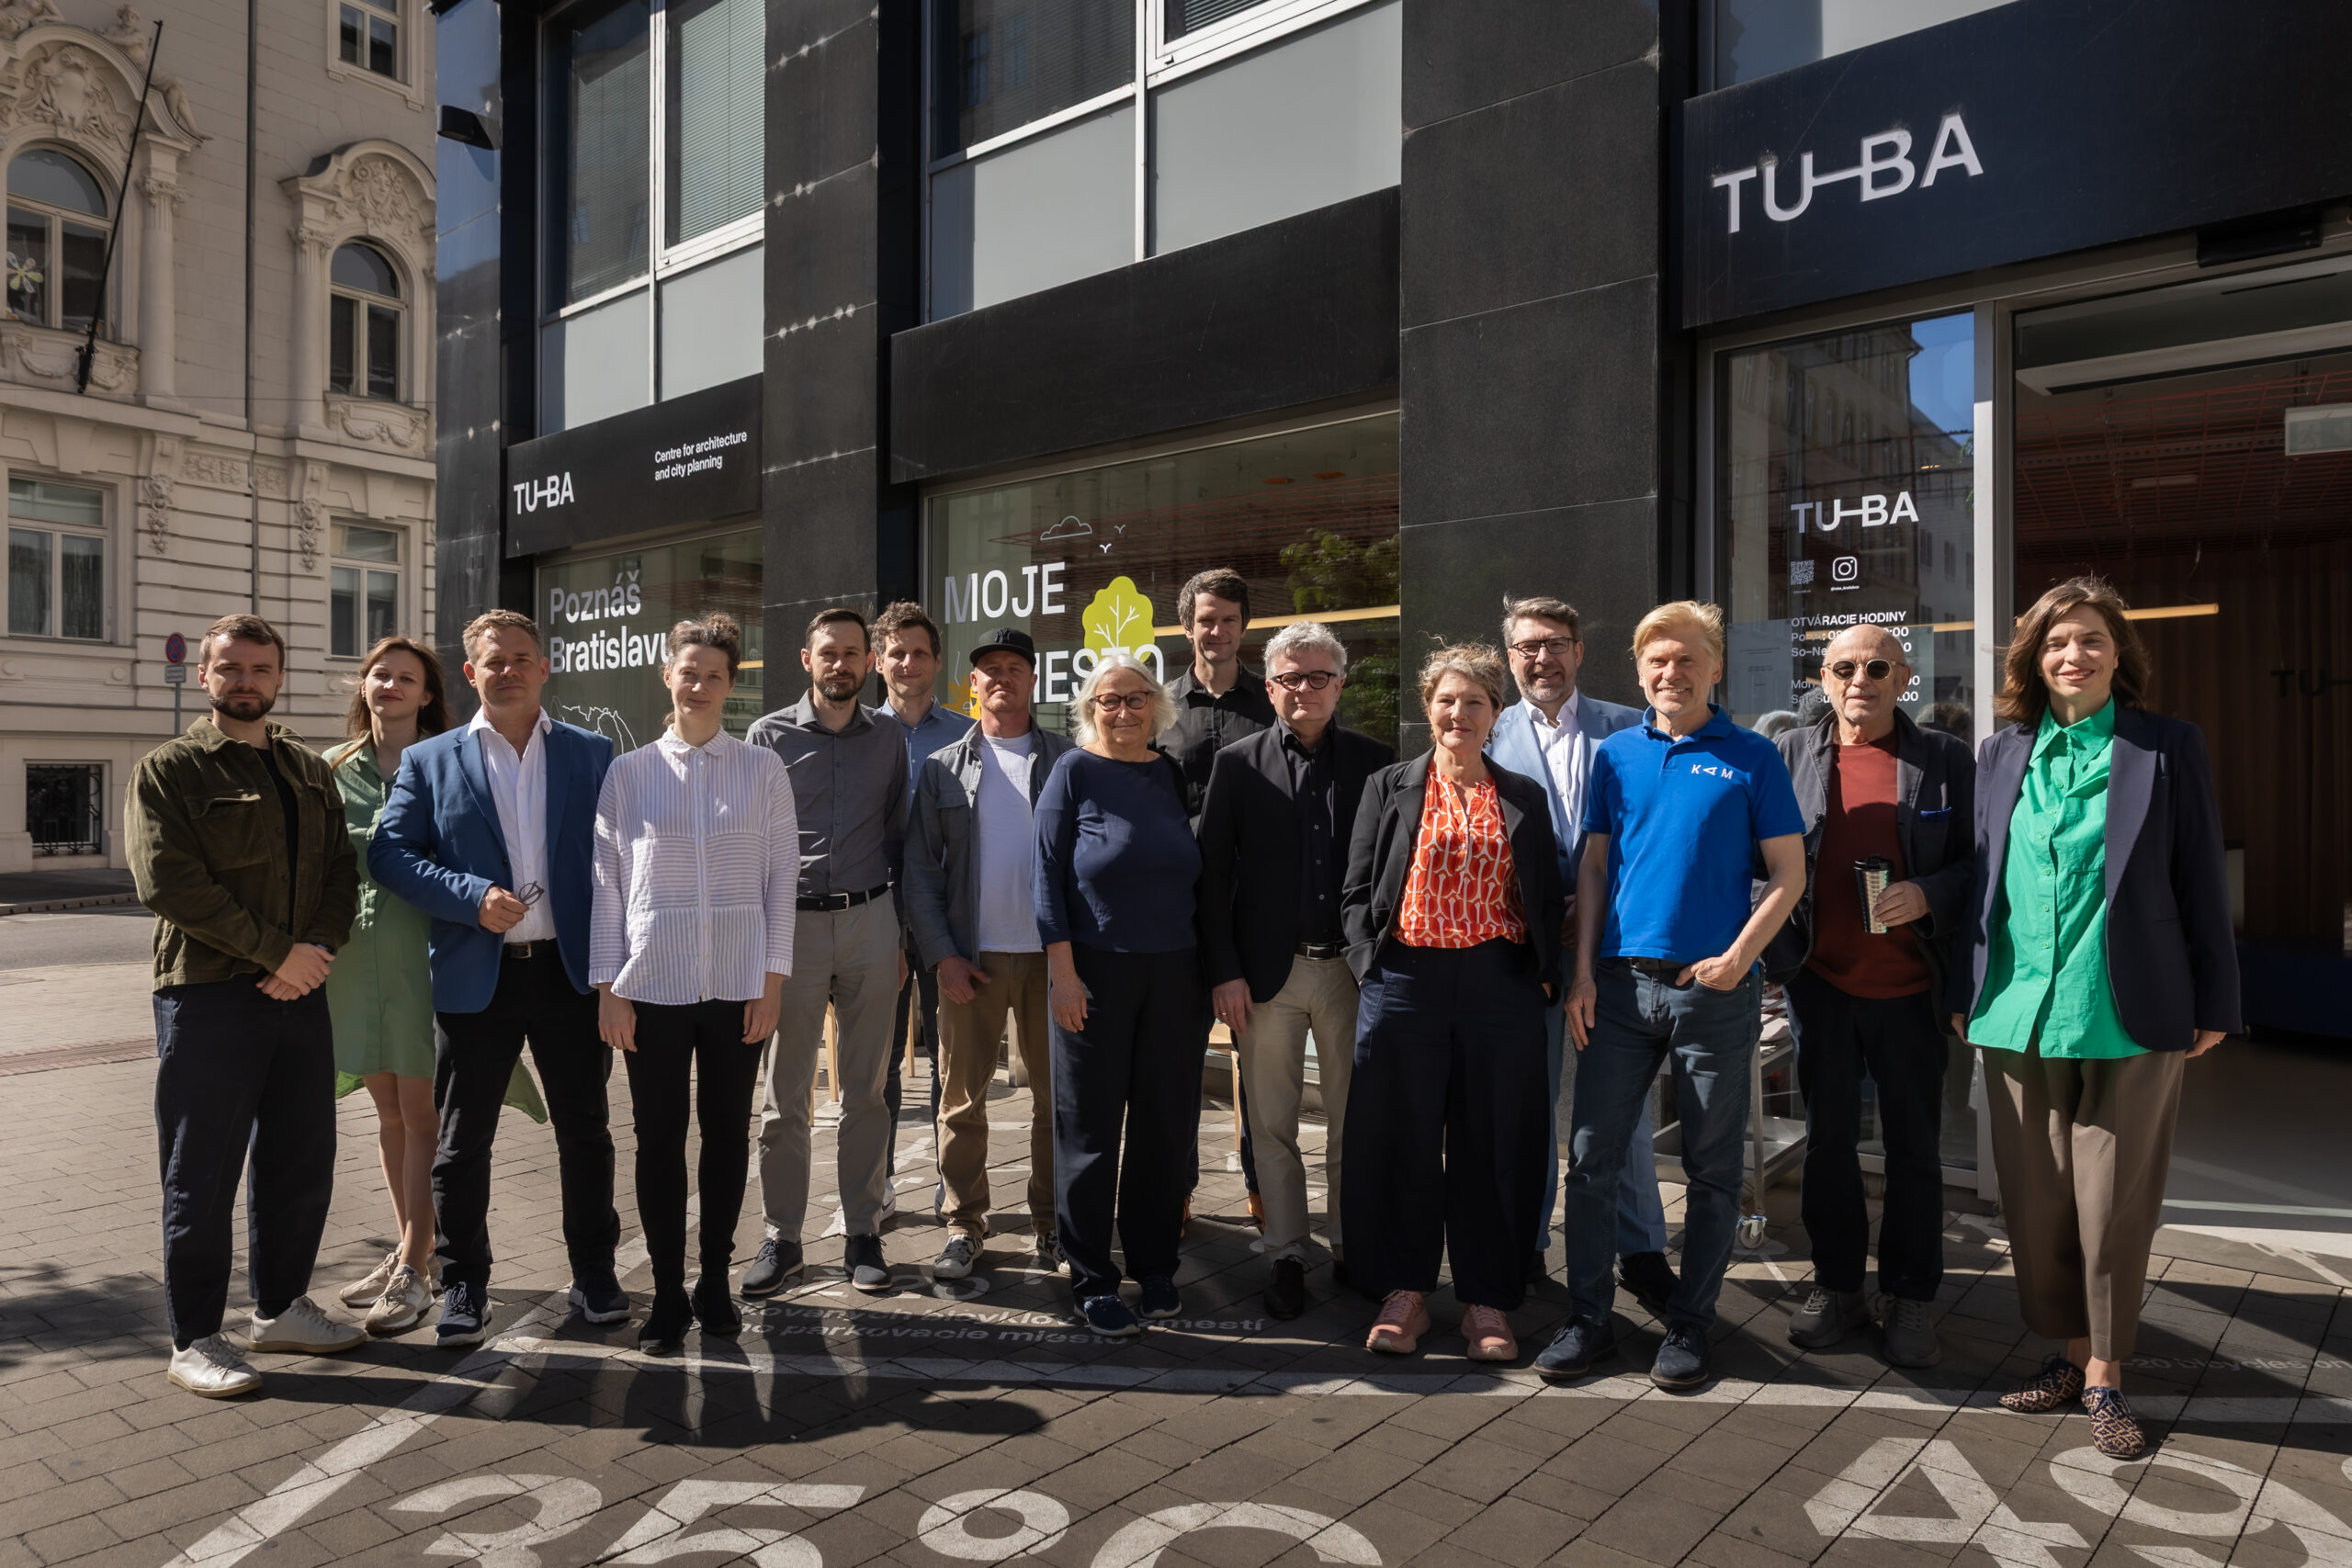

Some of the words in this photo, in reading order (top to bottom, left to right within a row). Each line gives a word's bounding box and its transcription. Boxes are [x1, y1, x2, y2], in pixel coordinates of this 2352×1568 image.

[654, 447, 682, 464] Centre
[683, 443, 695, 457] for
[695, 431, 747, 453] architecture
[654, 467, 671, 481] and
[671, 462, 686, 478] city
[687, 455, 723, 476] planning
[549, 570, 641, 626] Poznáš
[944, 561, 1066, 624] MOJE
[1791, 613, 1857, 627] OTVÁRACIE
[1859, 610, 1907, 624] HODINY
